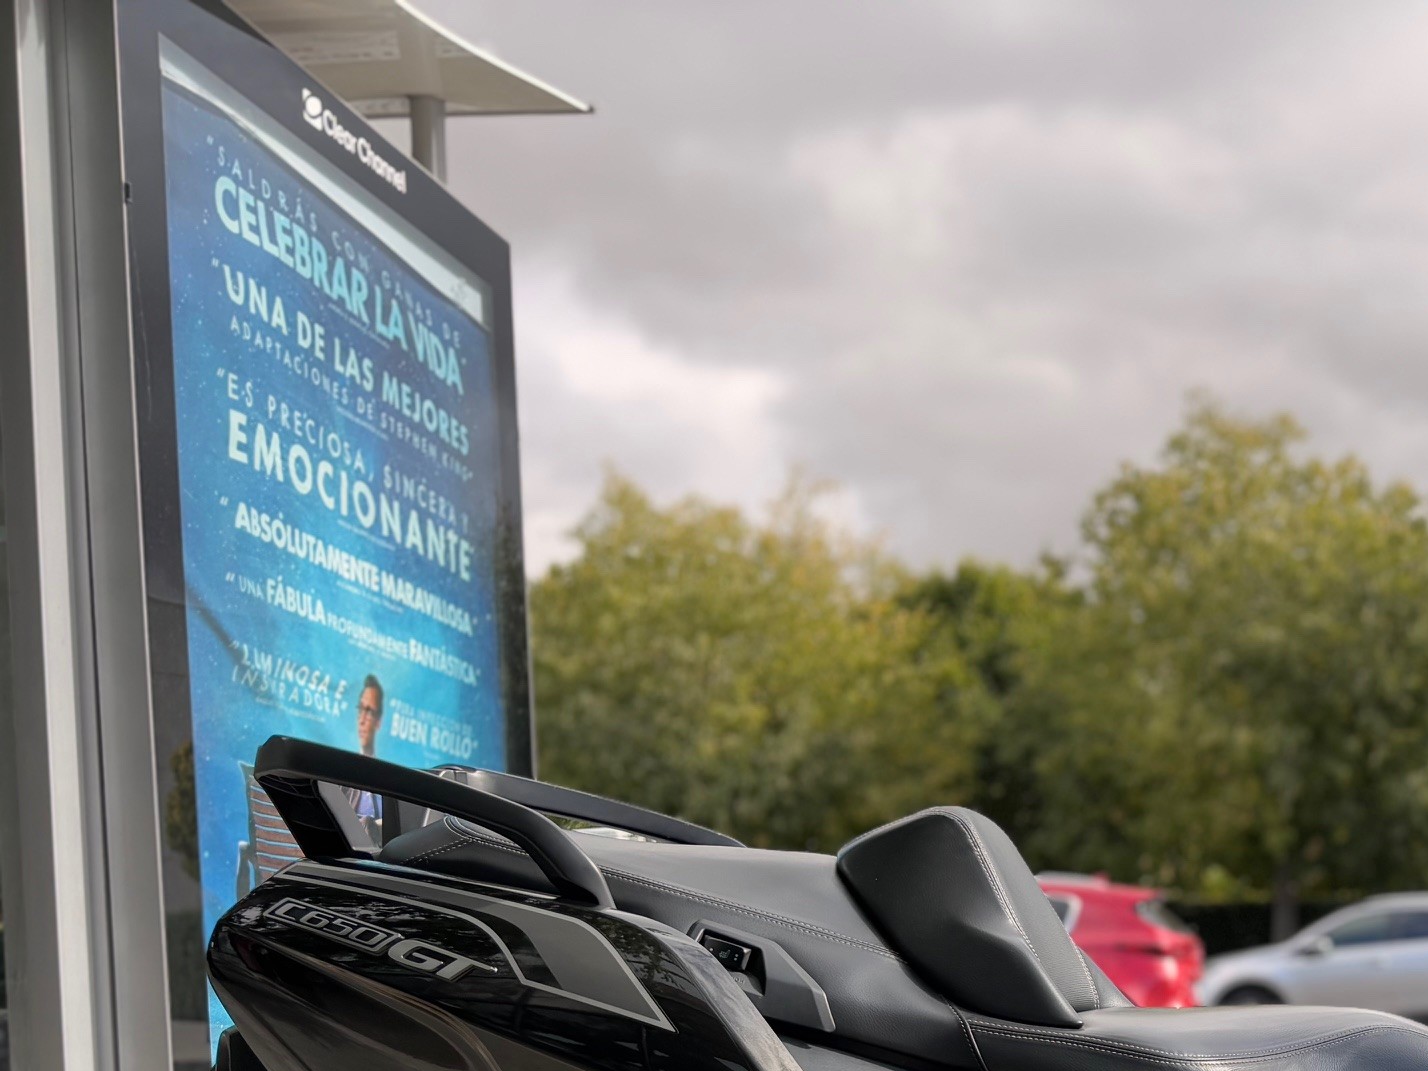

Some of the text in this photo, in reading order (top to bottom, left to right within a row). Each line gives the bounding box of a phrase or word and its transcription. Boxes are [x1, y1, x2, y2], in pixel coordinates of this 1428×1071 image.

[322, 108, 407, 194] Clear Channel
[214, 175, 370, 324] CELEBRAR
[374, 284, 409, 351] LA
[230, 314, 349, 406] ADAPTACIONES
[356, 396, 374, 421] DE
[297, 310, 326, 361] DE
[334, 336, 374, 392] LAS
[381, 370, 470, 456] MEJORES
[268, 394, 375, 483] PRECIOSA,
[383, 464, 457, 526] SINCERA
[266, 575, 327, 626] FÁBULA
[390, 711, 429, 748] BUEN
[387, 937, 500, 982] GT
